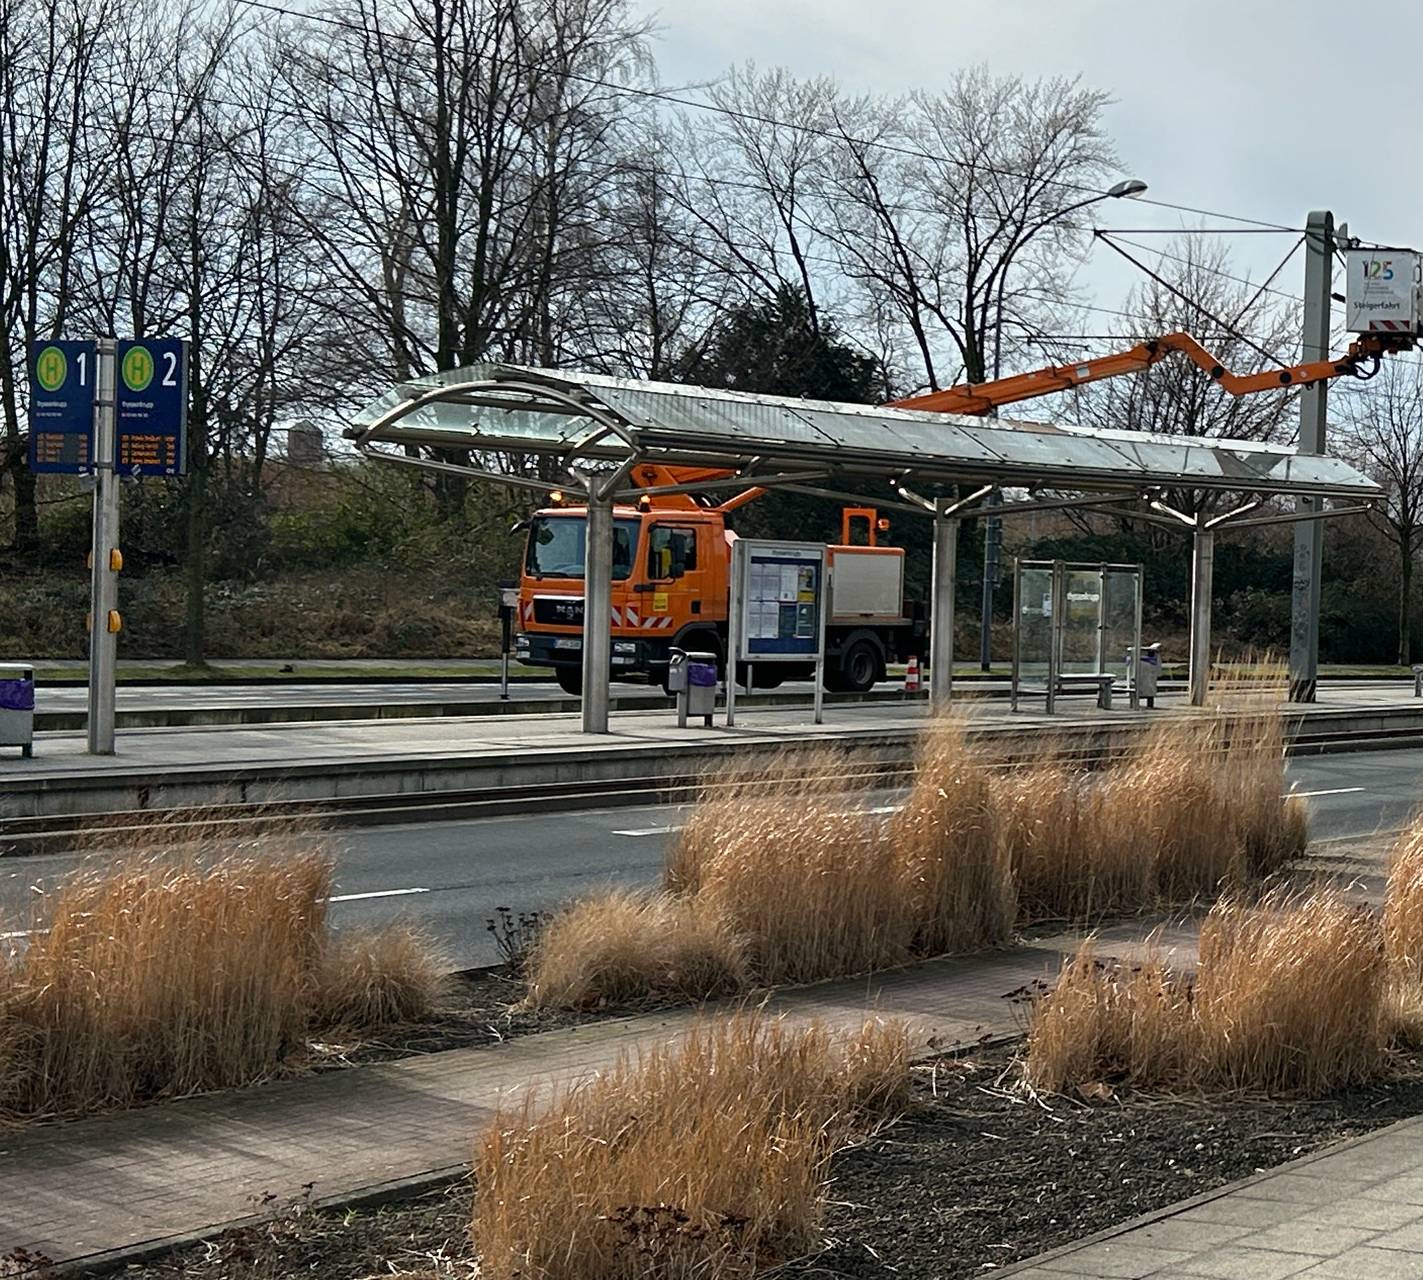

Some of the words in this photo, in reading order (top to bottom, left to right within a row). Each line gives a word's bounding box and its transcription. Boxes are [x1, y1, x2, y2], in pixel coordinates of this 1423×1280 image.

[1362, 261, 1393, 280] 125
[1353, 302, 1400, 310] Steigerfahrt
[77, 352, 86, 386] 1
[162, 351, 177, 386] 2
